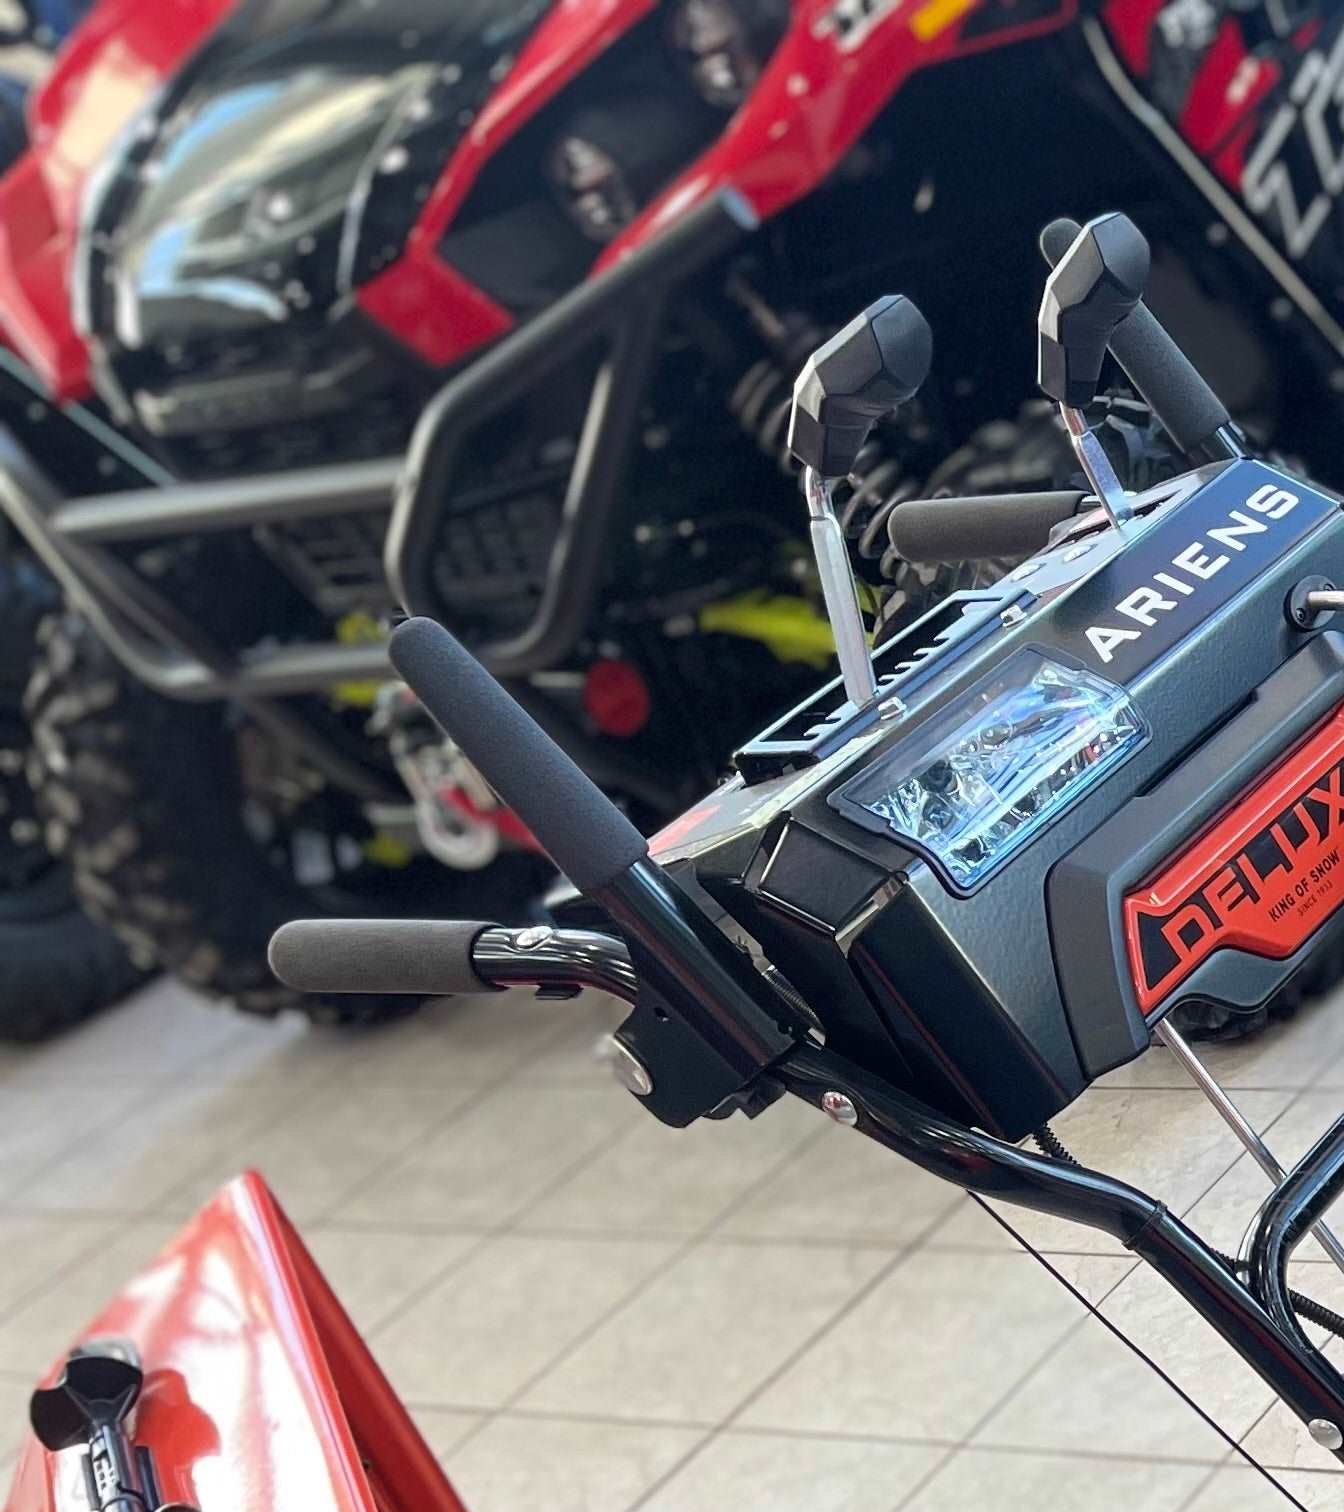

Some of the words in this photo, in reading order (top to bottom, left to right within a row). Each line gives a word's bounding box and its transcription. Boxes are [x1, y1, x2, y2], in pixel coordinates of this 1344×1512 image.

[1084, 483, 1300, 664] ARIENS
[1268, 893, 1296, 922] KING
[1295, 877, 1309, 897] OF
[1310, 848, 1340, 883] SNOW
[1297, 894, 1318, 917] SINCE
